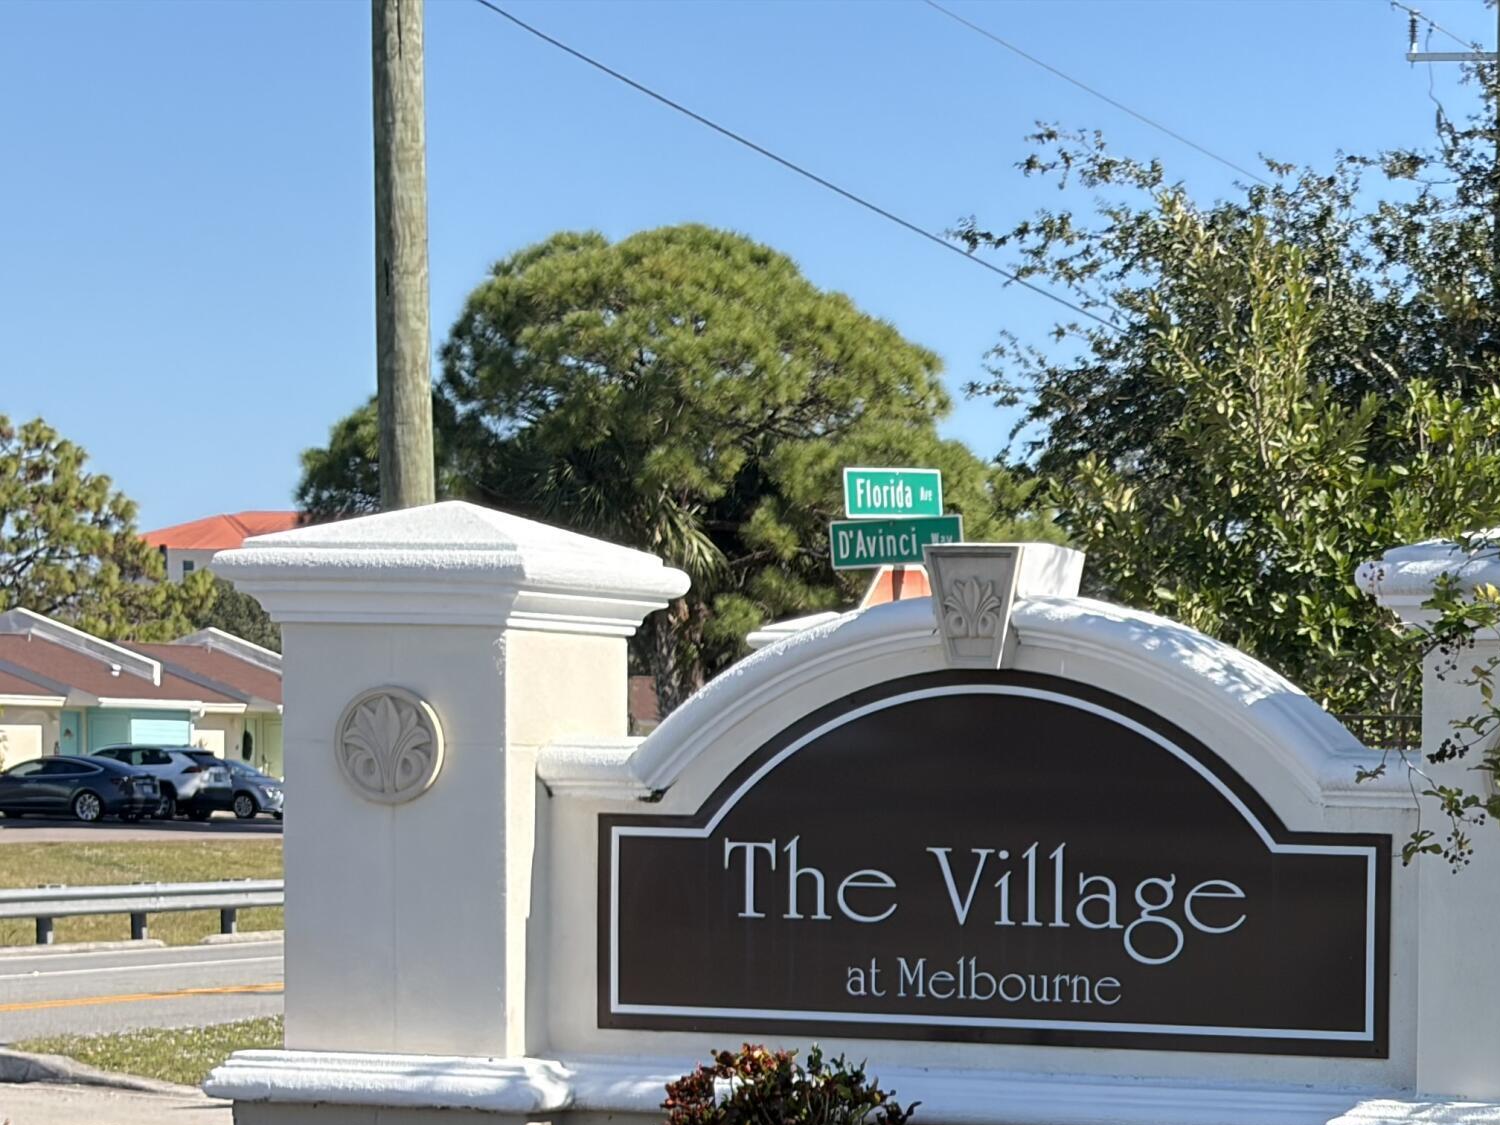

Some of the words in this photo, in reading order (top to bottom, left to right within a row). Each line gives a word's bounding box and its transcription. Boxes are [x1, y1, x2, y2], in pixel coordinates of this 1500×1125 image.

[856, 478, 913, 509] Florida
[919, 486, 933, 502] Ave
[838, 527, 918, 560] D'Avinci
[724, 835, 897, 923] The
[926, 841, 1247, 965] Village
[846, 957, 886, 997] at
[897, 955, 1122, 1006] Melbourne
